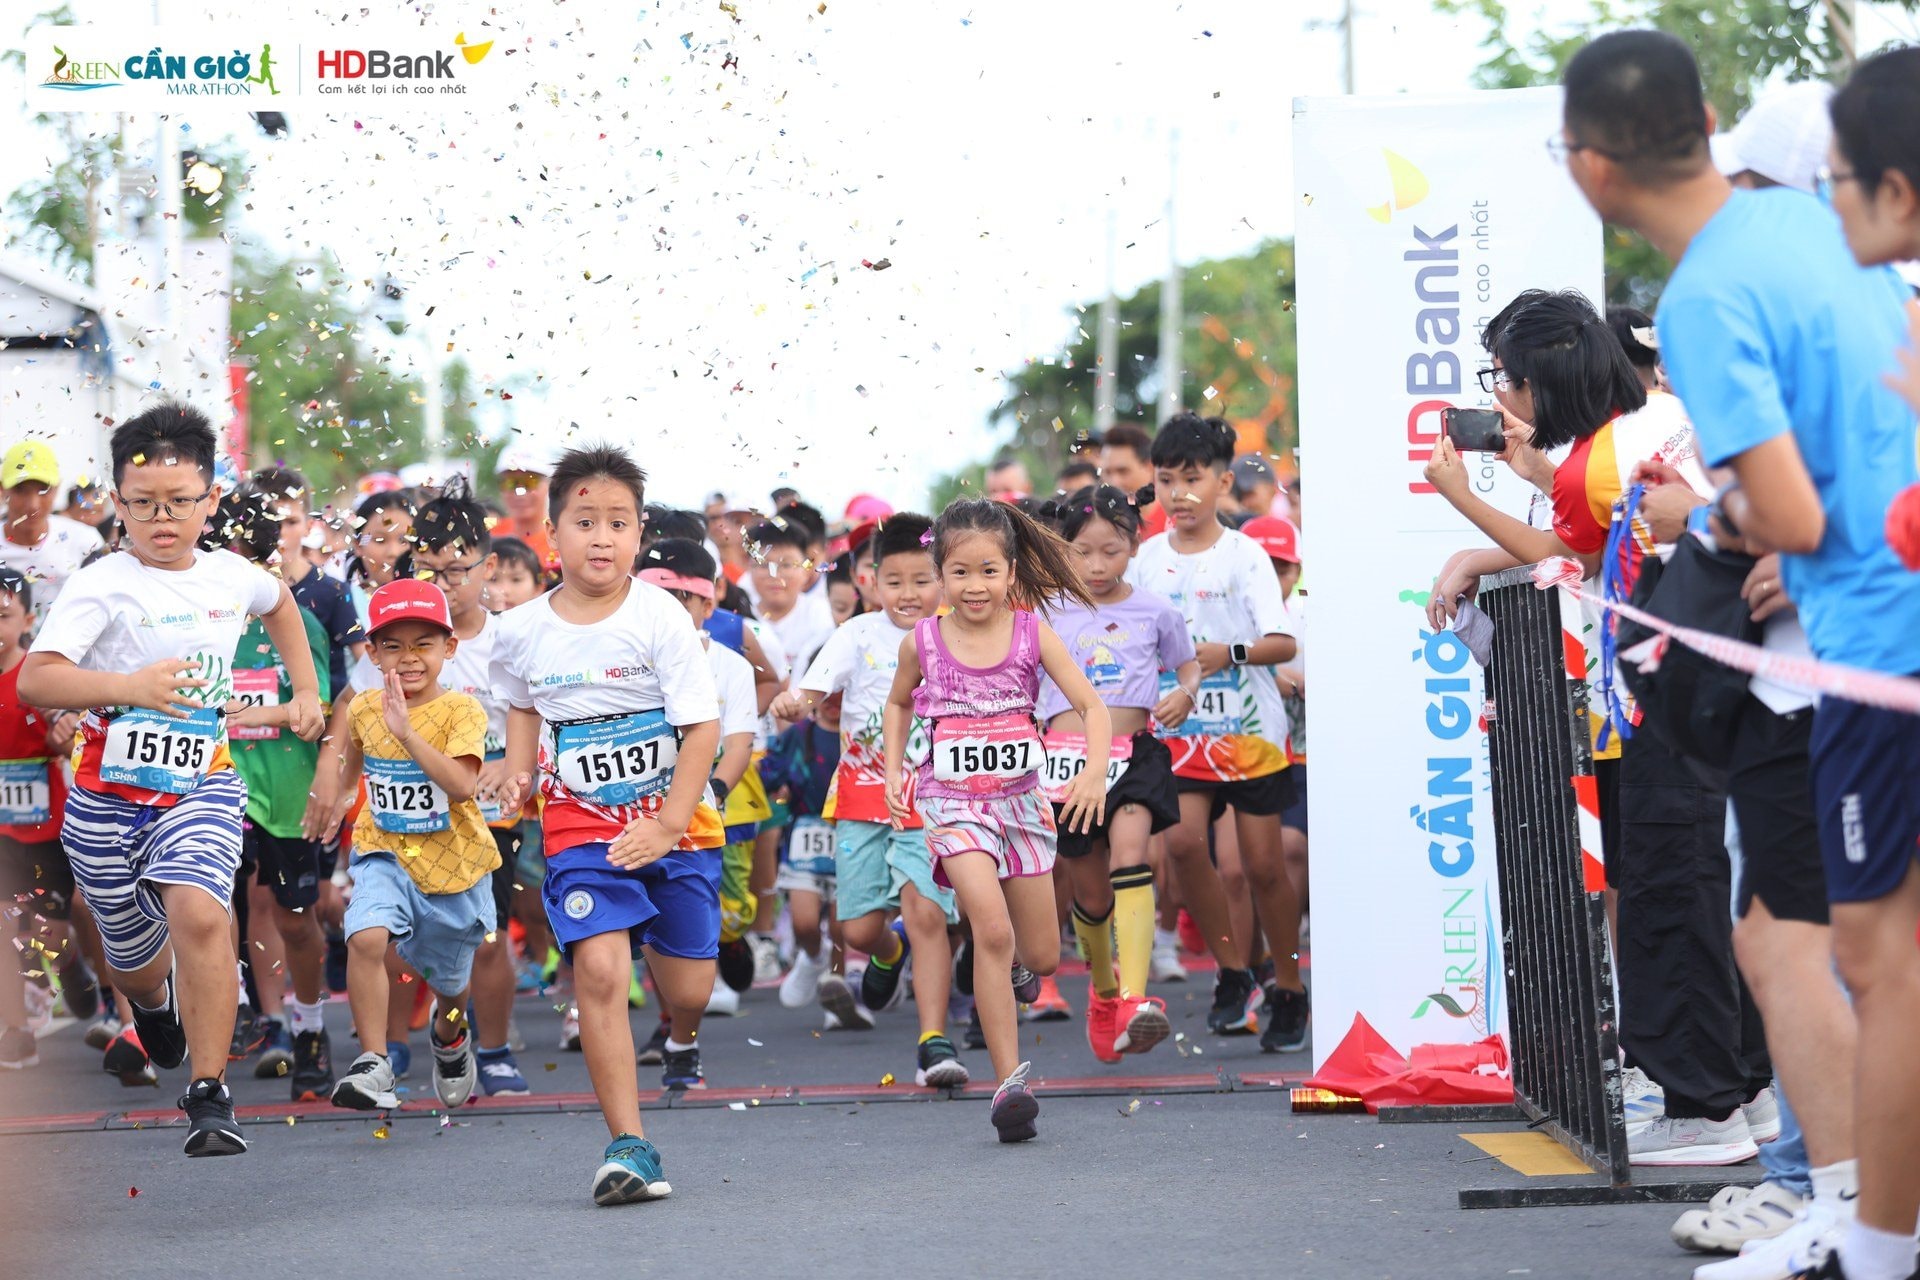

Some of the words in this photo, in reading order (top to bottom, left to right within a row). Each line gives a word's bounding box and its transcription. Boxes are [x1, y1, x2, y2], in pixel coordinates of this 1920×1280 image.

[1470, 199, 1489, 250] nhất
[1476, 263, 1490, 303] cao
[1659, 424, 1691, 458] HDBank
[604, 664, 651, 679] HDBank
[1412, 628, 1472, 741] GIỜ
[126, 730, 205, 769] 15135
[577, 740, 659, 784] 15137
[949, 741, 1030, 773] 15037
[0, 785, 33, 805] 111
[369, 781, 434, 811] 15123
[1410, 757, 1474, 878] CẦN
[1438, 888, 1478, 1018] GREEN
